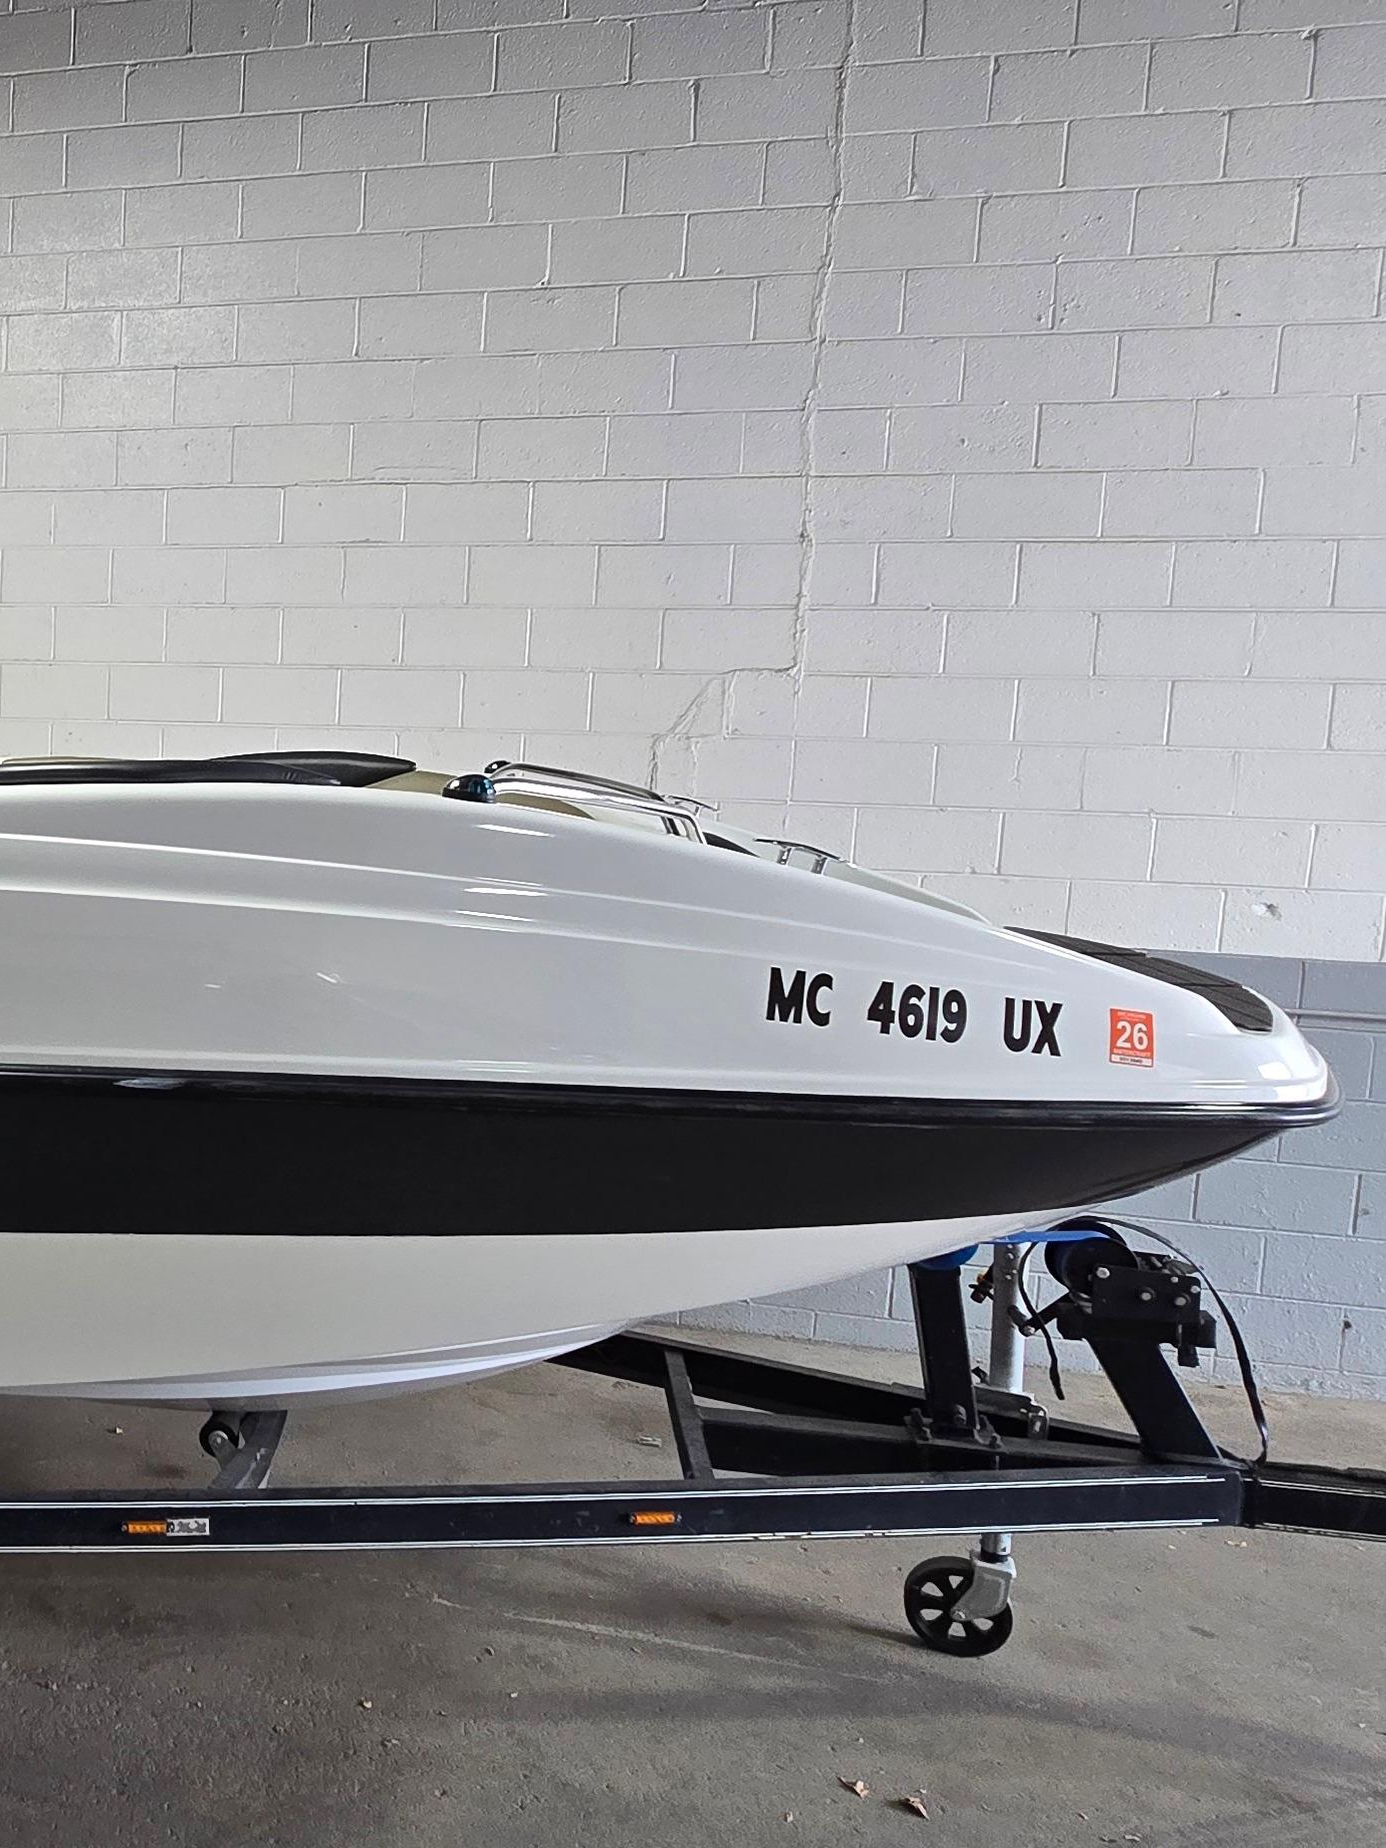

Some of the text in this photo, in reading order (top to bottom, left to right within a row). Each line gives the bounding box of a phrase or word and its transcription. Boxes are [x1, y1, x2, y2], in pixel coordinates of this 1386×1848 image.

[765, 967, 1063, 1056] MC 4619 UX
[1116, 1020, 1149, 1051] 26
